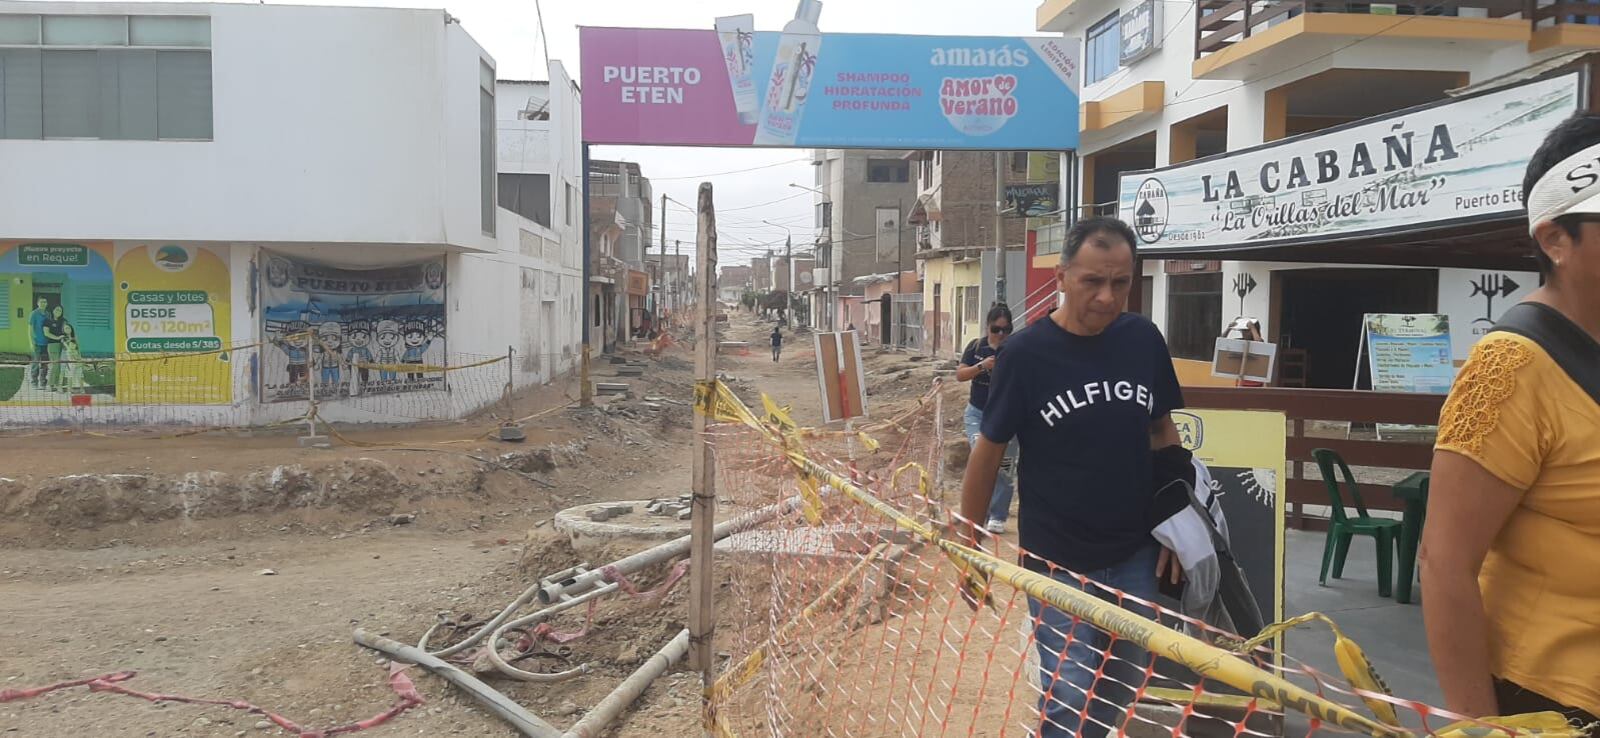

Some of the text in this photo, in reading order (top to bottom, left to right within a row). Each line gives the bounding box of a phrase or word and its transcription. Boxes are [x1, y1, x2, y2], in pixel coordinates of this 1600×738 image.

[1040, 44, 1072, 78] LIMITADA
[1047, 40, 1076, 70] EDICIÓN
[603, 66, 701, 85] PUERTO
[837, 72, 910, 83] SHAMPOO
[621, 86, 683, 104] ETEN
[824, 84, 922, 97] HIDRATACIÓN
[833, 100, 911, 111] PROFUNDA
[1201, 121, 1459, 202] LA CABAÑA
[1455, 187, 1524, 210] Puerto Ete
[1251, 200, 1318, 226] Orillas
[1326, 192, 1362, 218] del
[131, 293, 205, 303] Casas y lotes
[131, 309, 176, 319] DESDE
[131, 321, 150, 333] 70
[130, 341, 162, 349] Cuotas
[164, 341, 191, 349] desde
